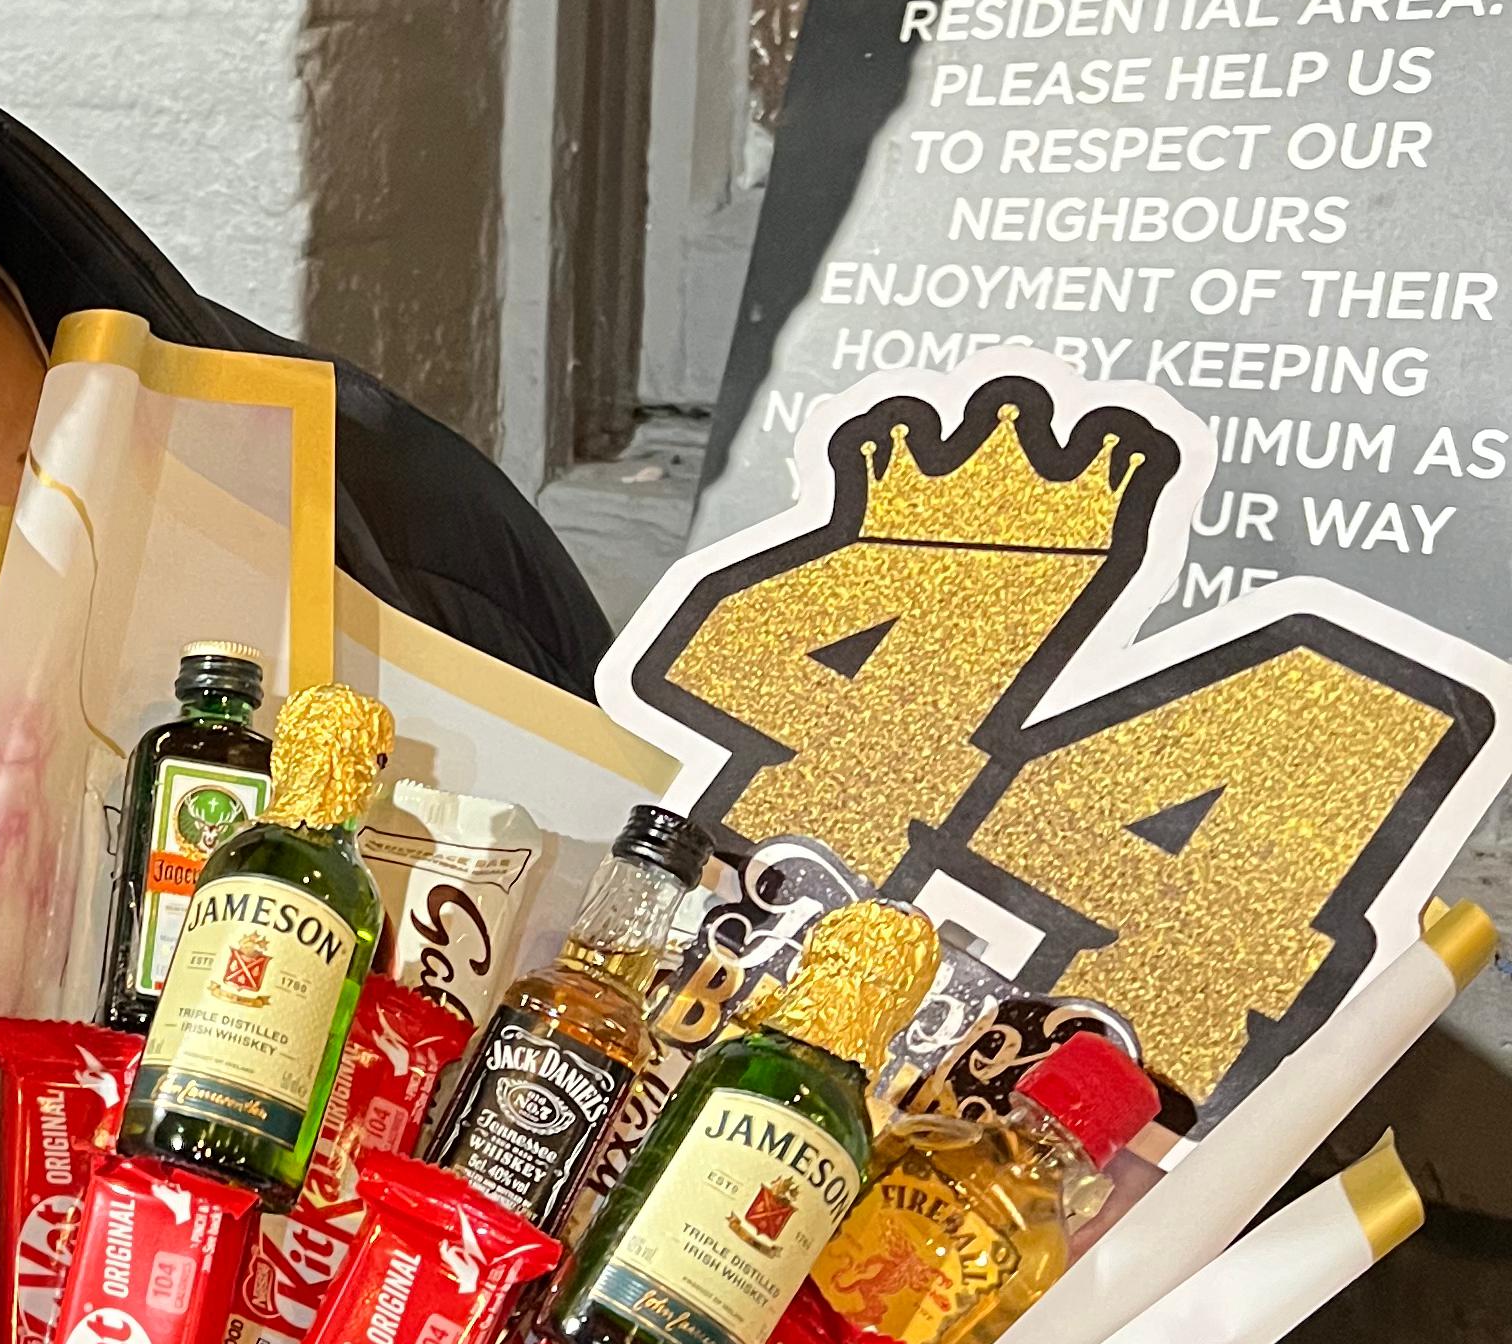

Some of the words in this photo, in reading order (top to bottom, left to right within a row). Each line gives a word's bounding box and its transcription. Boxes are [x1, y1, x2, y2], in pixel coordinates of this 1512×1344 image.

[930, 57, 1152, 107] PLEASE
[1165, 50, 1329, 101] HELP
[1347, 46, 1435, 95] US
[910, 130, 984, 174] TO
[1000, 124, 1271, 174] RESPECT
[1288, 121, 1433, 171] OUR
[947, 196, 1350, 243] NEIGHBOURS
[820, 262, 1175, 313] ENJOYMENT
[1189, 269, 1282, 315] OF
[1301, 270, 1499, 321] THEIR
[1054, 336, 1133, 381] BY
[1147, 340, 1429, 397] KEEPING
[1413, 426, 1510, 479] AS
[1302, 496, 1457, 555] WAY
[188, 893, 343, 965] JAMESON
[178, 1007, 219, 1025] TRIPLE
[222, 1015, 289, 1046] DISTILLED
[181, 1022, 213, 1037] IRISH
[215, 1025, 278, 1056] WHISKEY
[487, 1040, 542, 1072] JACK
[41, 1089, 73, 1185] ORIGINAL
[367, 1107, 391, 1139] 104
[477, 1108, 558, 1164] Tennessee
[469, 1134, 547, 1184] WHISKEY
[705, 1109, 851, 1224] JAMESON
[102, 1199, 135, 1299] ORIGINAL
[681, 1222, 731, 1262] TRIPLE
[730, 1254, 781, 1300] DISTILLED
[881, 1185, 988, 1286] FIREBALL
[152, 1262, 177, 1298] 104
[682, 1242, 720, 1268] IRISH
[721, 1264, 770, 1309] WHISKEY
